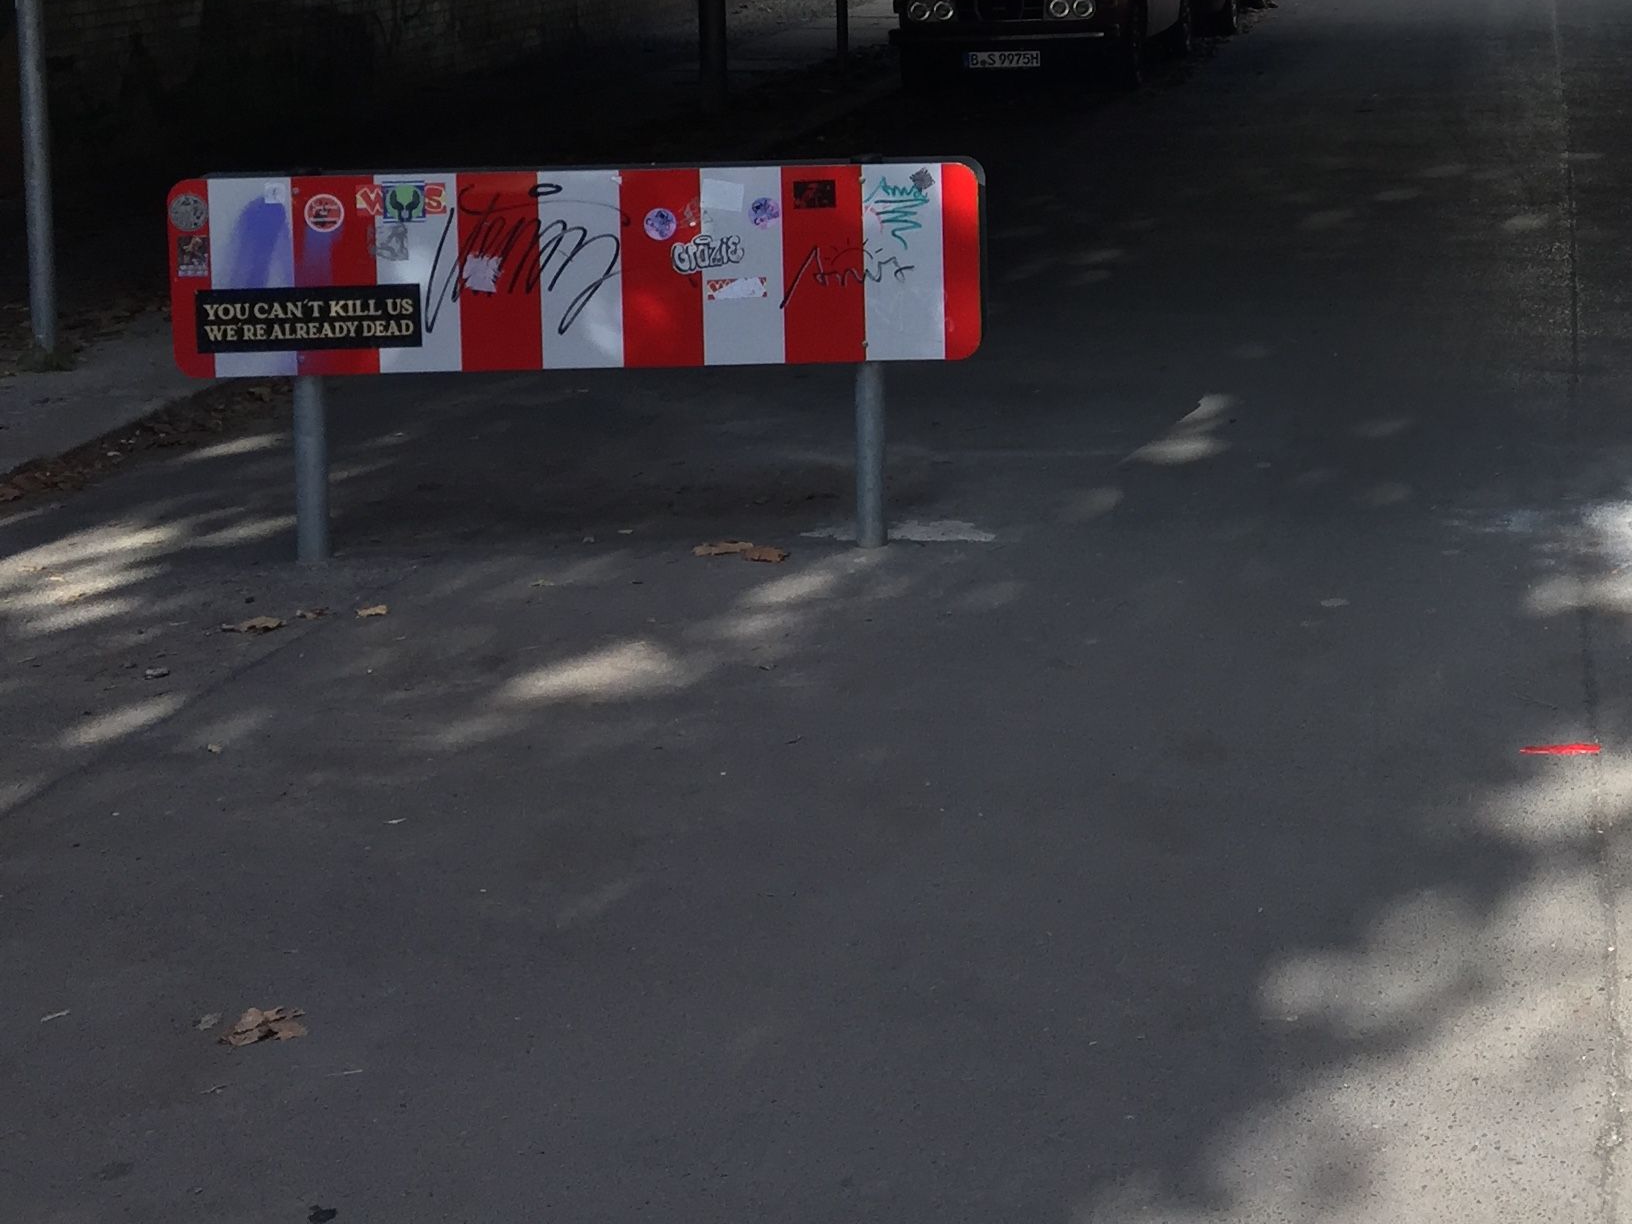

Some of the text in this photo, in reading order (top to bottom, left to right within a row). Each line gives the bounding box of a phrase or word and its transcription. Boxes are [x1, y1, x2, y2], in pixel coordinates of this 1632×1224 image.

[203, 298, 414, 320] YOU CAN'T KILL US
[204, 320, 414, 342] WE'RE ALREADY DEAD
